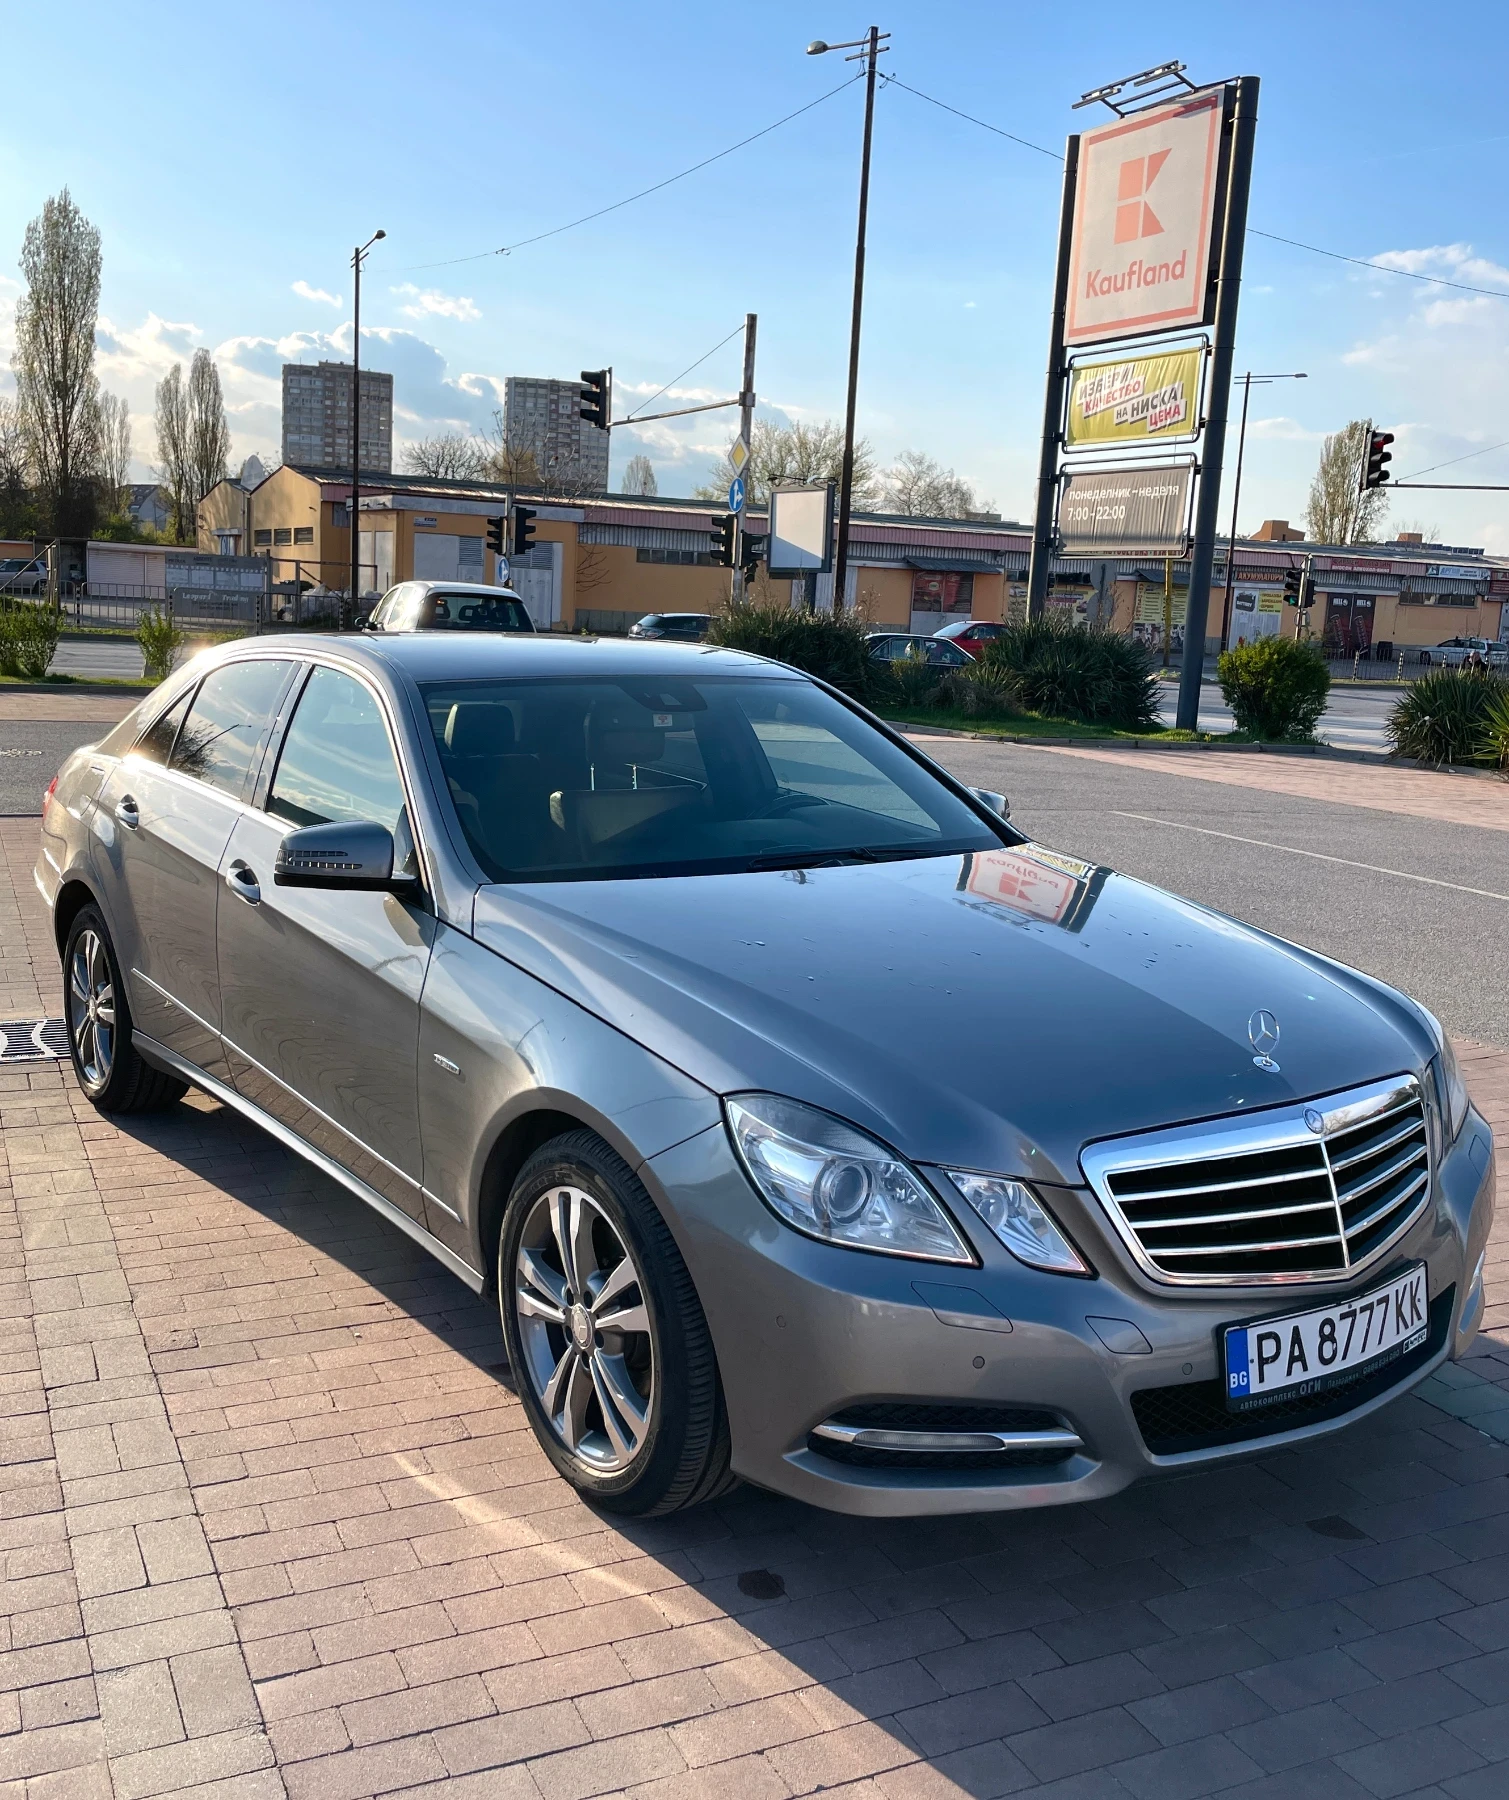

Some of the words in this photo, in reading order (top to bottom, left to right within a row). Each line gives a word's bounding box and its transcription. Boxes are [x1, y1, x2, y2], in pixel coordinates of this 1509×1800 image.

[1085, 250, 1187, 299] Kaufland
[1079, 364, 1135, 401] ИЗБЕРИ
[1084, 380, 1141, 413] КАЧЕСТВО
[1116, 407, 1128, 420] НА
[1131, 386, 1178, 418] НИСКА
[1149, 404, 1181, 427] ЦЕНА
[1067, 507, 1089, 521] 7:00
[1096, 505, 1126, 520] 22:00
[1238, 571, 1284, 580] АКУМУЛАТОРИ
[1256, 1325, 1309, 1384] PA
[1318, 1293, 1390, 1366] 8777
[1395, 1275, 1423, 1336] KK
[1229, 1371, 1248, 1389] BG
[1240, 1390, 1297, 1410] АВТОКОМПЛЕКС
[1299, 1379, 1322, 1395] ОГИ
